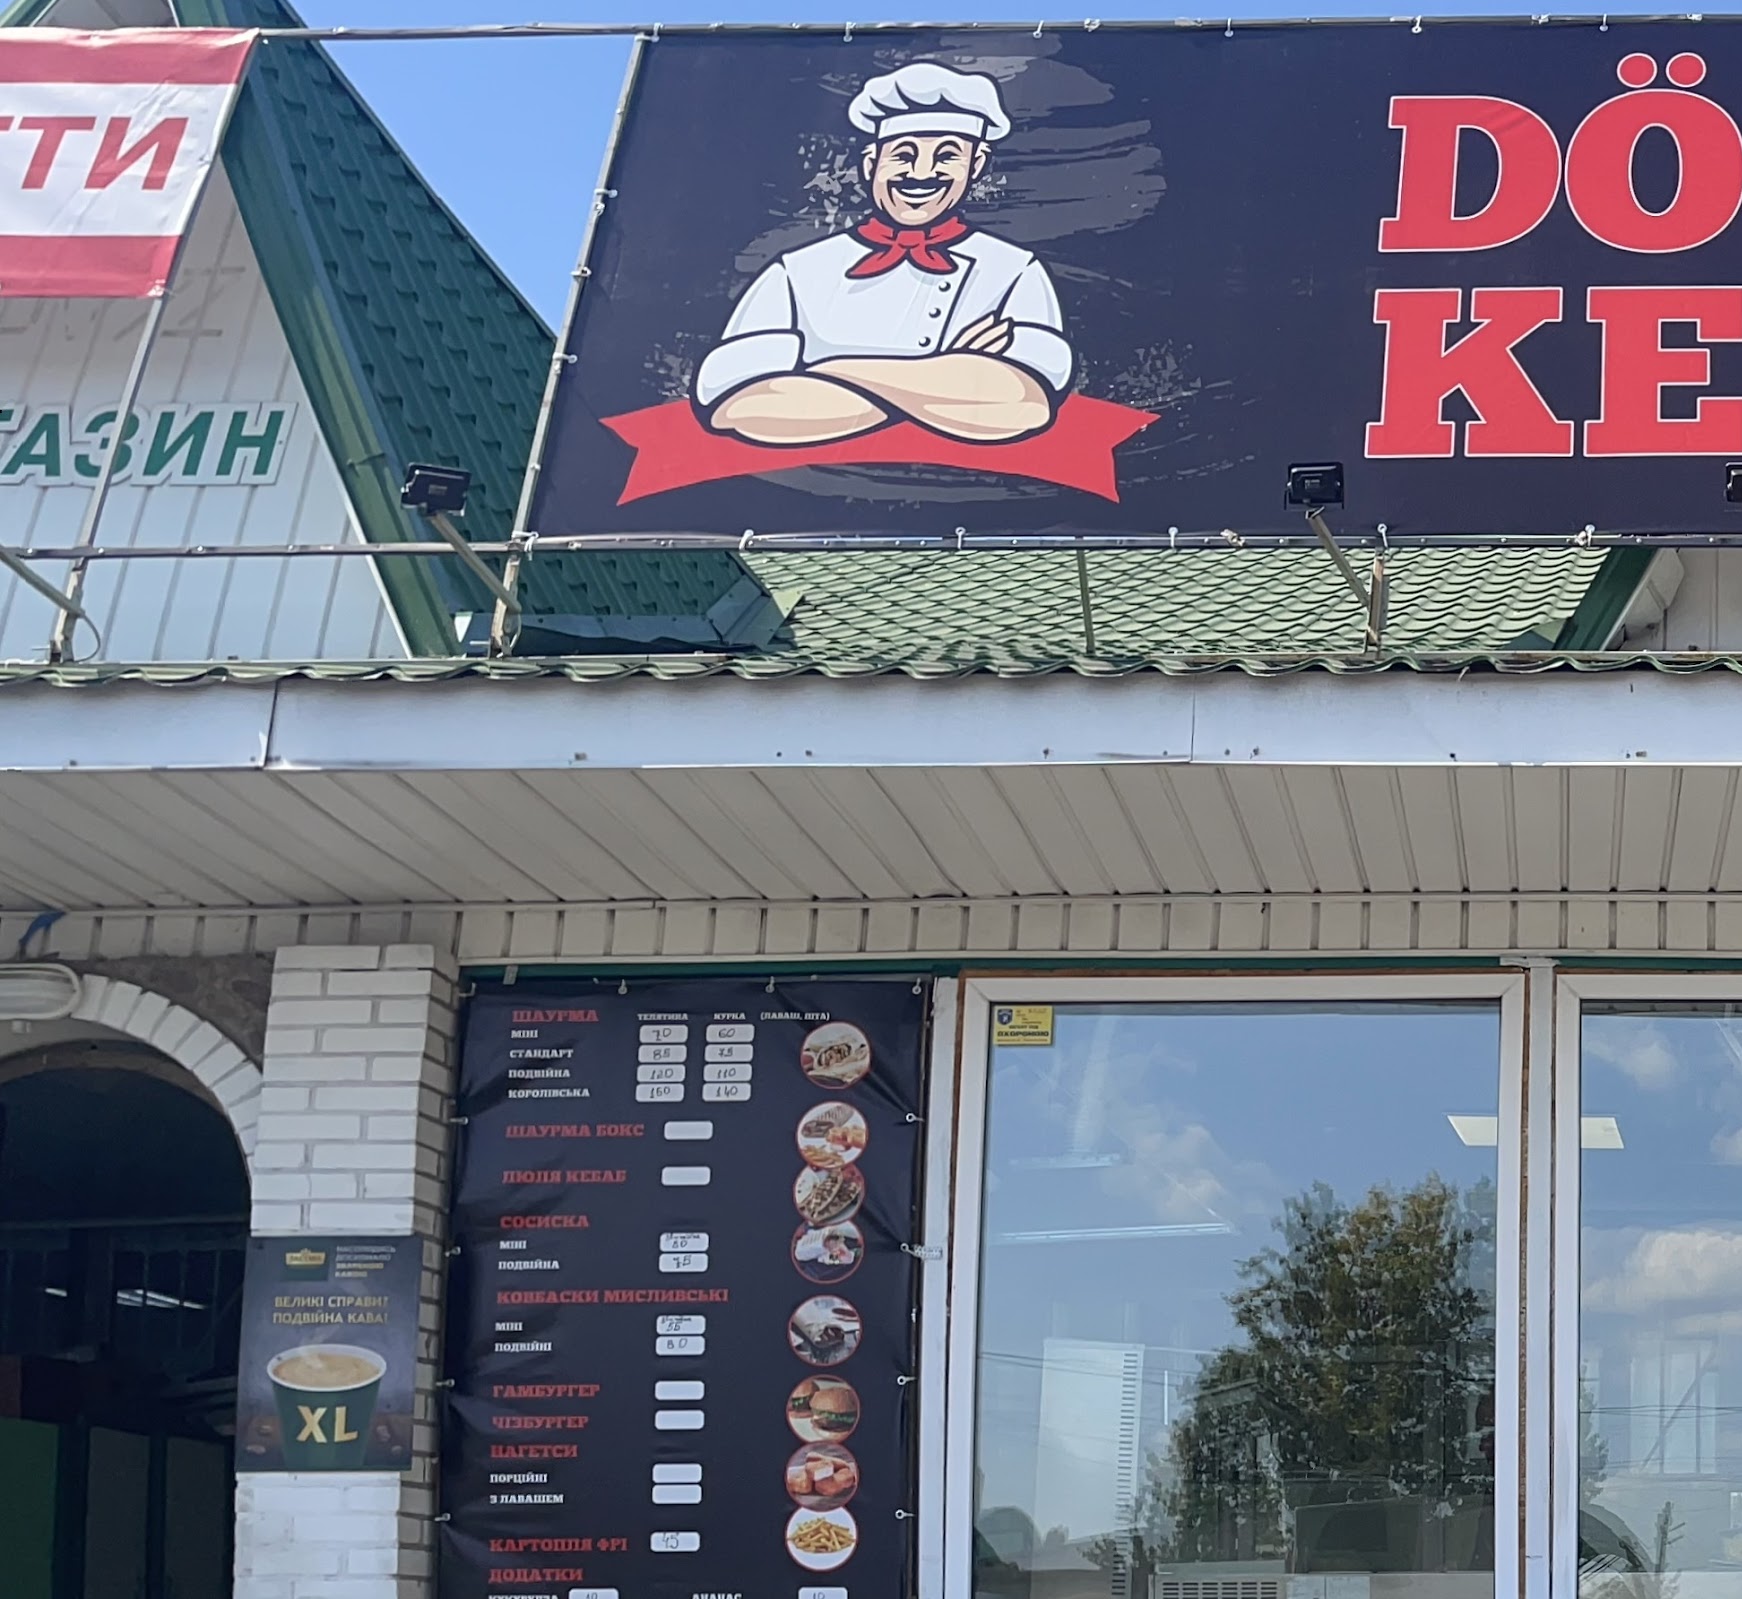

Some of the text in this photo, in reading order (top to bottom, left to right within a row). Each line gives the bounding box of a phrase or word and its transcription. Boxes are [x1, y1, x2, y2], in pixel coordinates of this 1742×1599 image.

[0, 115, 189, 191] ТИ
[511, 1009, 599, 1023] ШАУРМА
[637, 1012, 689, 1021] ТЕЛЯТИНА
[713, 1012, 746, 1021] КУРКА
[511, 1029, 539, 1039] МІНІ
[718, 1028, 736, 1038] 60
[509, 1048, 574, 1059] СТАНДАРТ
[508, 1067, 571, 1079] ПОДВІЙНА
[507, 1087, 590, 1098] КОРОЛІВСЬКА
[716, 1086, 738, 1097] 140
[505, 1124, 645, 1138] ШАУРМА БОКС
[502, 1169, 627, 1184] ЛЮЛЯ КЕБАБ
[500, 1215, 590, 1228] СОСИСКА
[499, 1240, 527, 1250] МІНІ
[498, 1259, 559, 1271] ПОДВІЙНА
[274, 1296, 324, 1308] ВЕЛИКІ
[497, 1288, 729, 1304] КОВБАСКИ МИСЛИВСЬКІ
[273, 1310, 389, 1325] ПОДВІЙНА КАВА!
[495, 1321, 523, 1331] МІНІ
[495, 1341, 552, 1352] ПОДВІЙНІ
[492, 1384, 600, 1398] ГАМБУРГЕР
[296, 1405, 359, 1443] XL
[491, 1415, 589, 1430] ЧІЗБУРГЕР
[490, 1444, 578, 1458] НАГЕТСИ
[489, 1472, 548, 1484] ПОРЦІЙНІ
[489, 1494, 564, 1504] З ЛАВАШЕМ
[489, 1538, 628, 1552] КАРТОПЛЯ ФРІ
[488, 1568, 583, 1583] ДОДАТКИ
